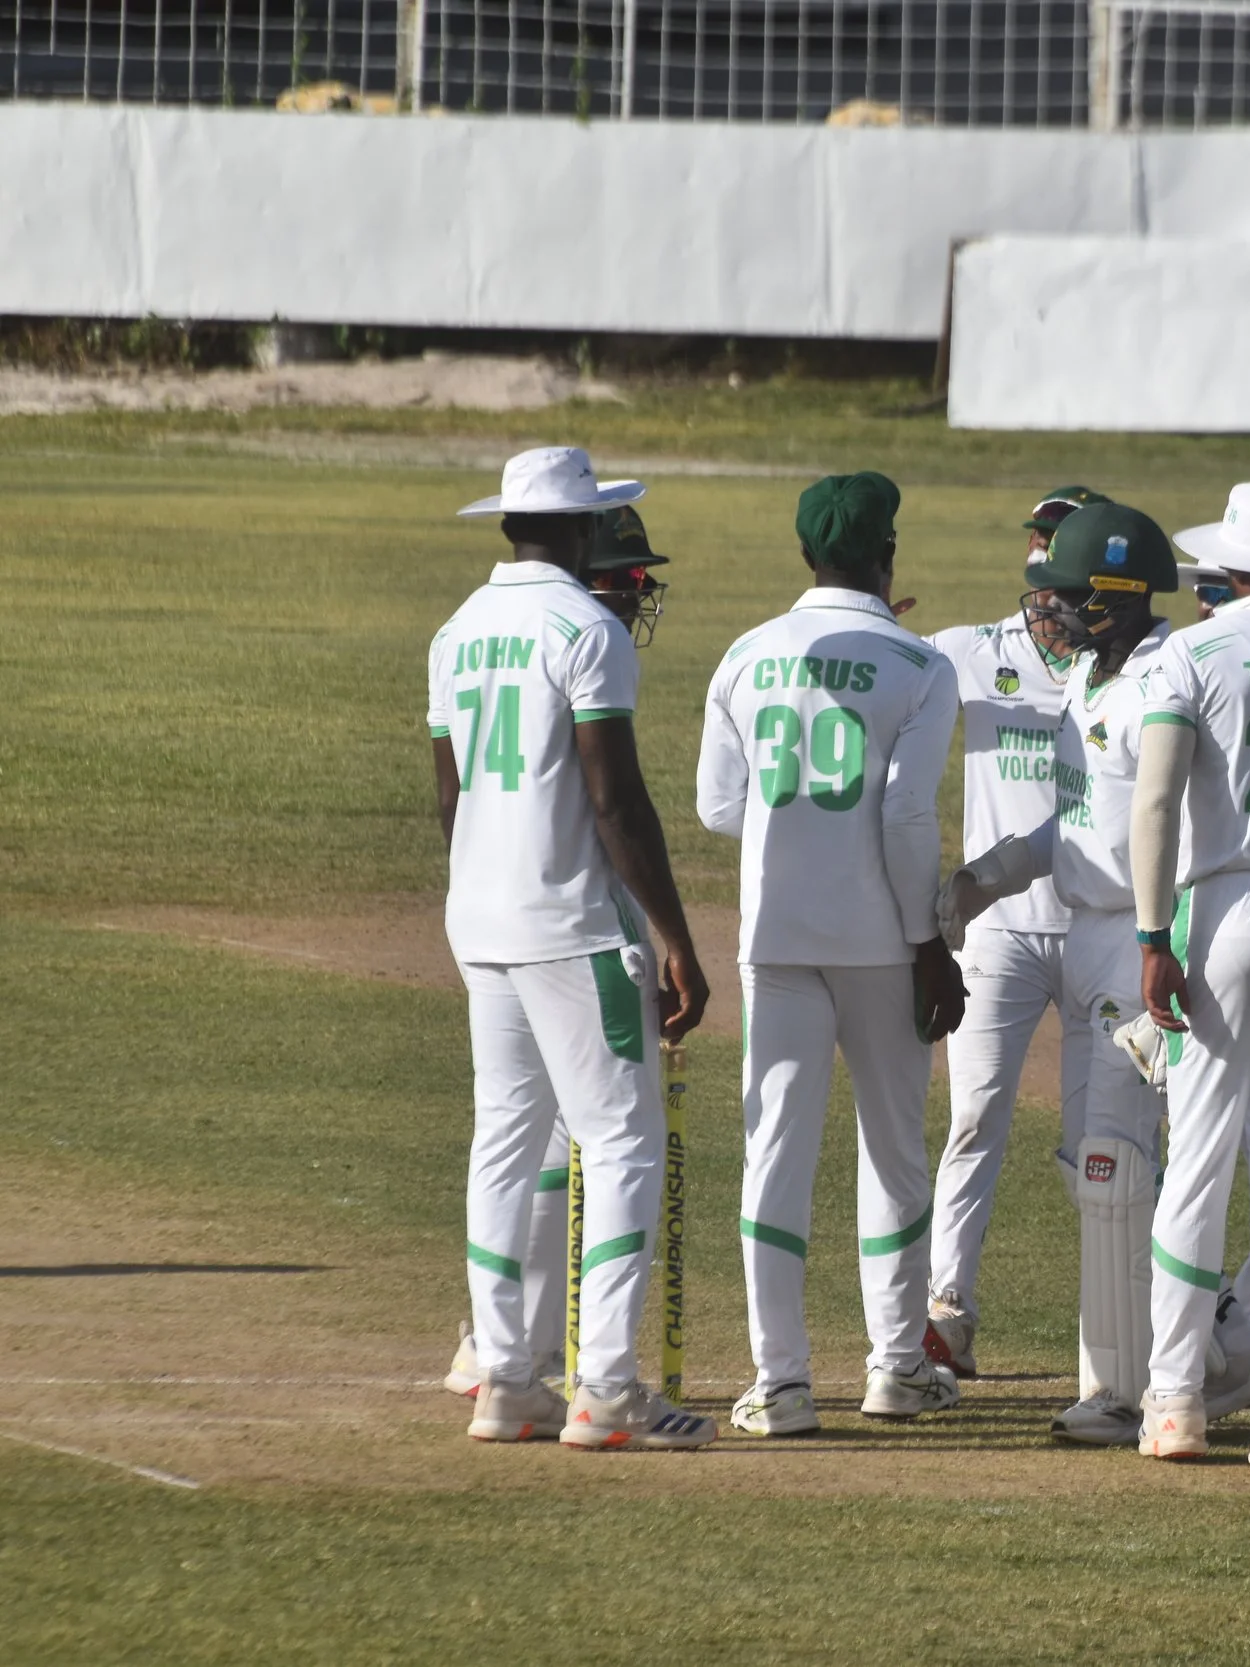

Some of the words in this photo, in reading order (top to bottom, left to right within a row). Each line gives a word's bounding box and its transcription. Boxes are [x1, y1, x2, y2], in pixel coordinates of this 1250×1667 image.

[452, 636, 535, 676] JOHN
[753, 656, 877, 694] CYRUS
[456, 685, 525, 792] 74
[755, 704, 865, 812] 39
[666, 1131, 685, 1350] CHAMPIONSHIP
